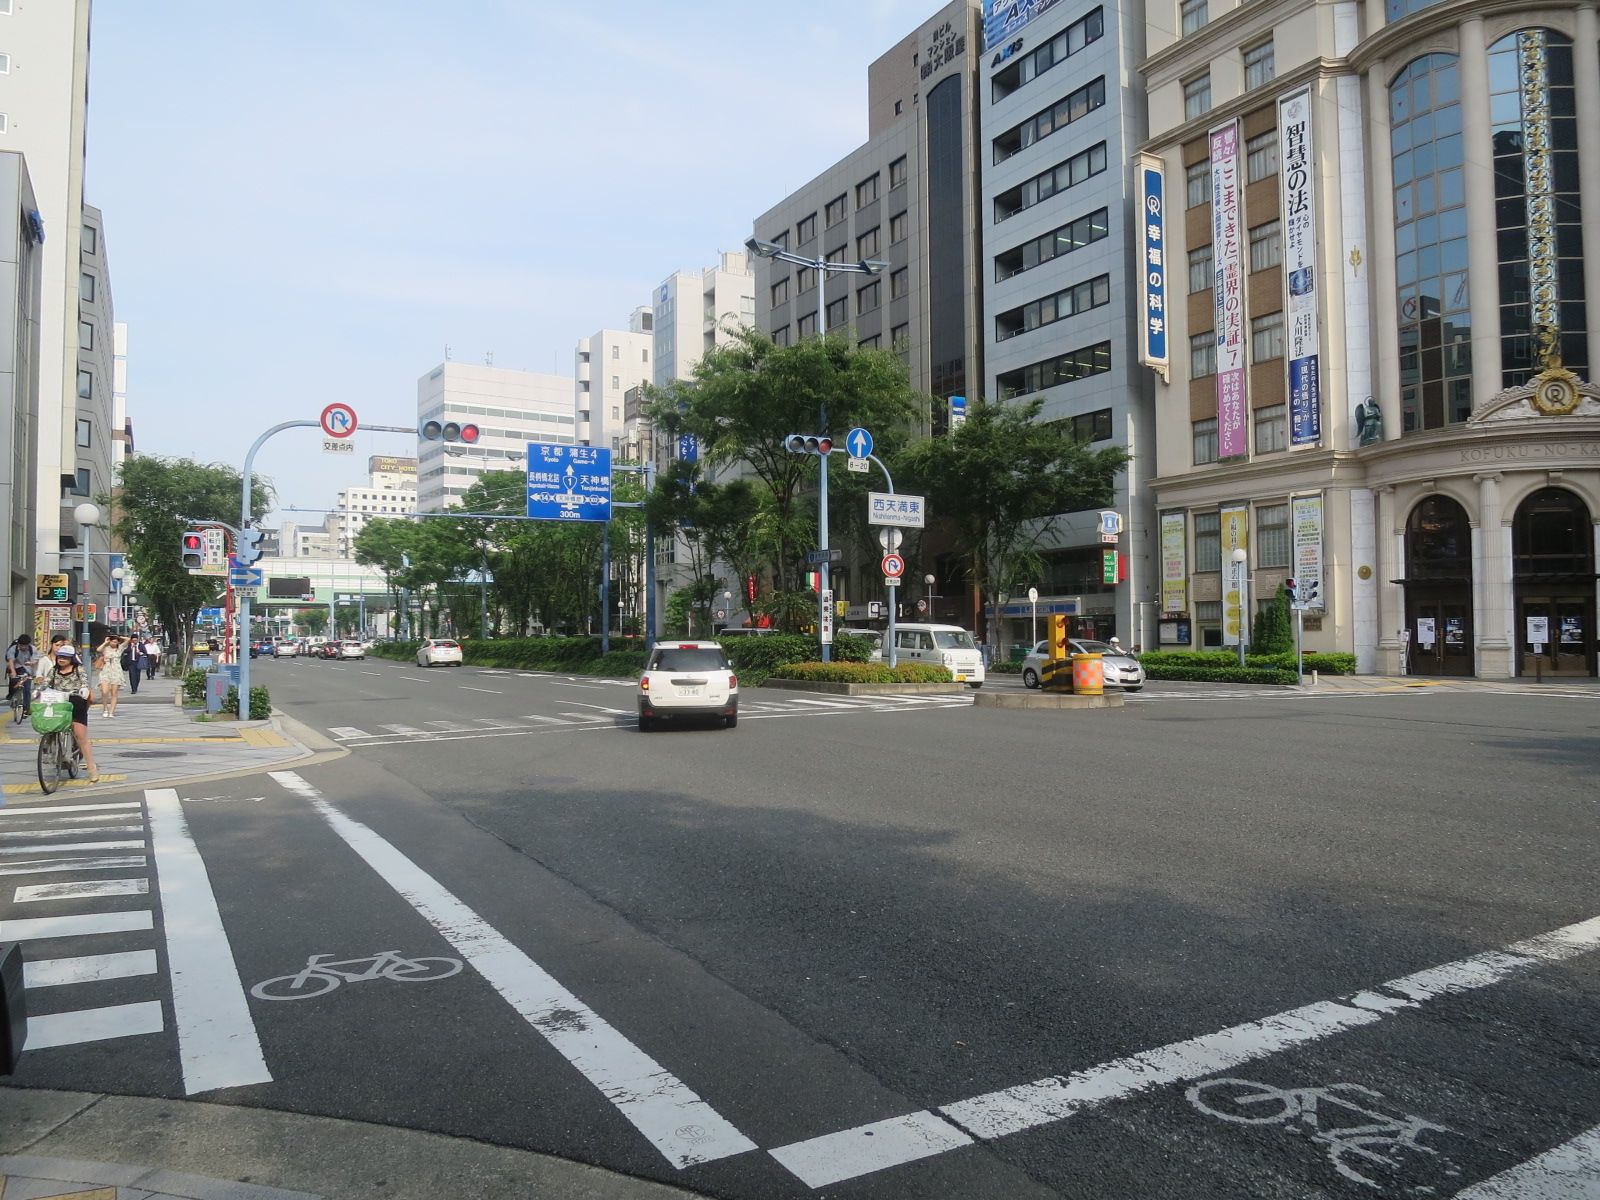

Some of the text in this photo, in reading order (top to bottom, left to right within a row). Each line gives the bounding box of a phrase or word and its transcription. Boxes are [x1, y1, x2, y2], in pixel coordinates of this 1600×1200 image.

[1286, 120, 1308, 216] 智慧の法
[1147, 224, 1163, 335] 幸福の科学
[323, 441, 354, 452] 交差点内
[540, 446, 563, 457] 京都
[873, 498, 920, 514] 西天満東
[559, 510, 581, 519] 300m
